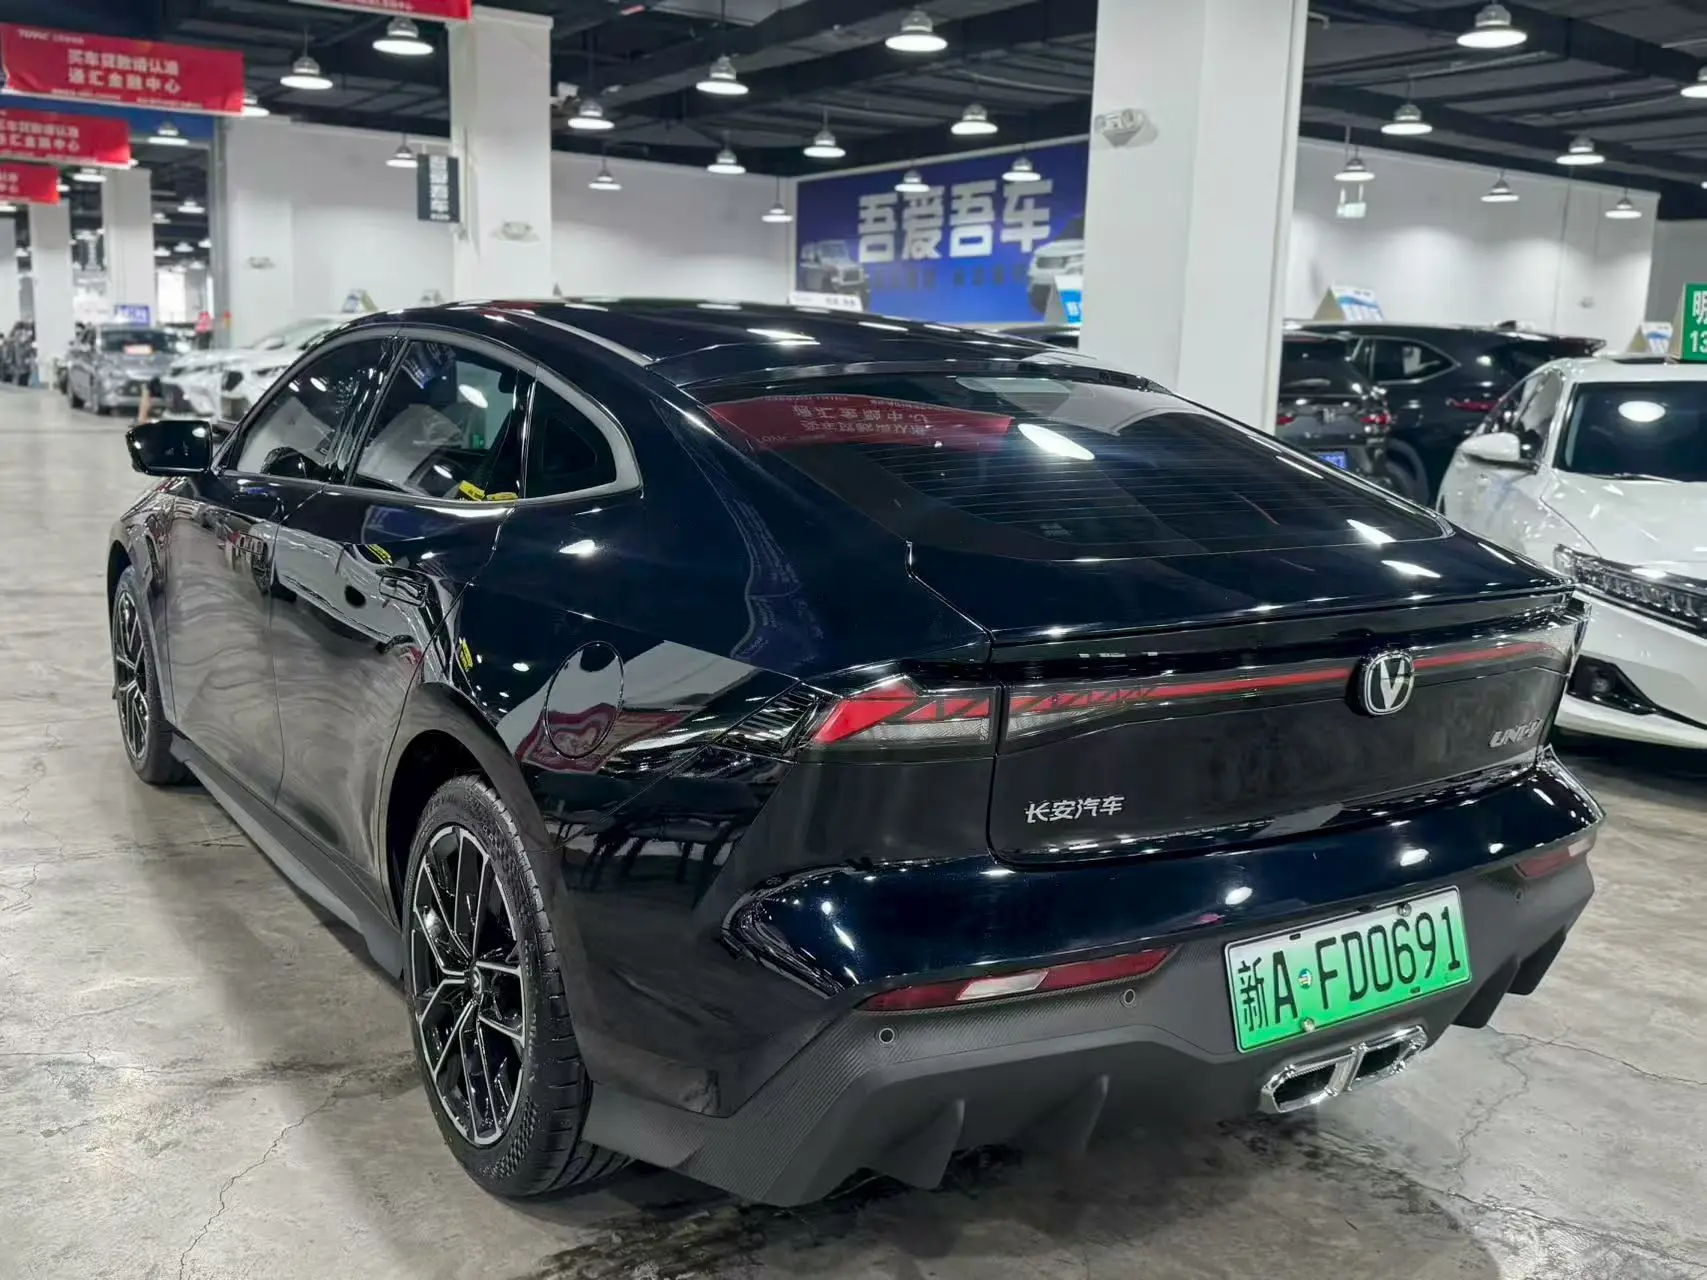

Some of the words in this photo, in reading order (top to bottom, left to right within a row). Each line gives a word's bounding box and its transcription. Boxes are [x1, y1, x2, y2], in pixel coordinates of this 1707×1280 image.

[858, 179, 1053, 263] 吾爱吾车
[1025, 796, 1125, 824] 长安汽车
